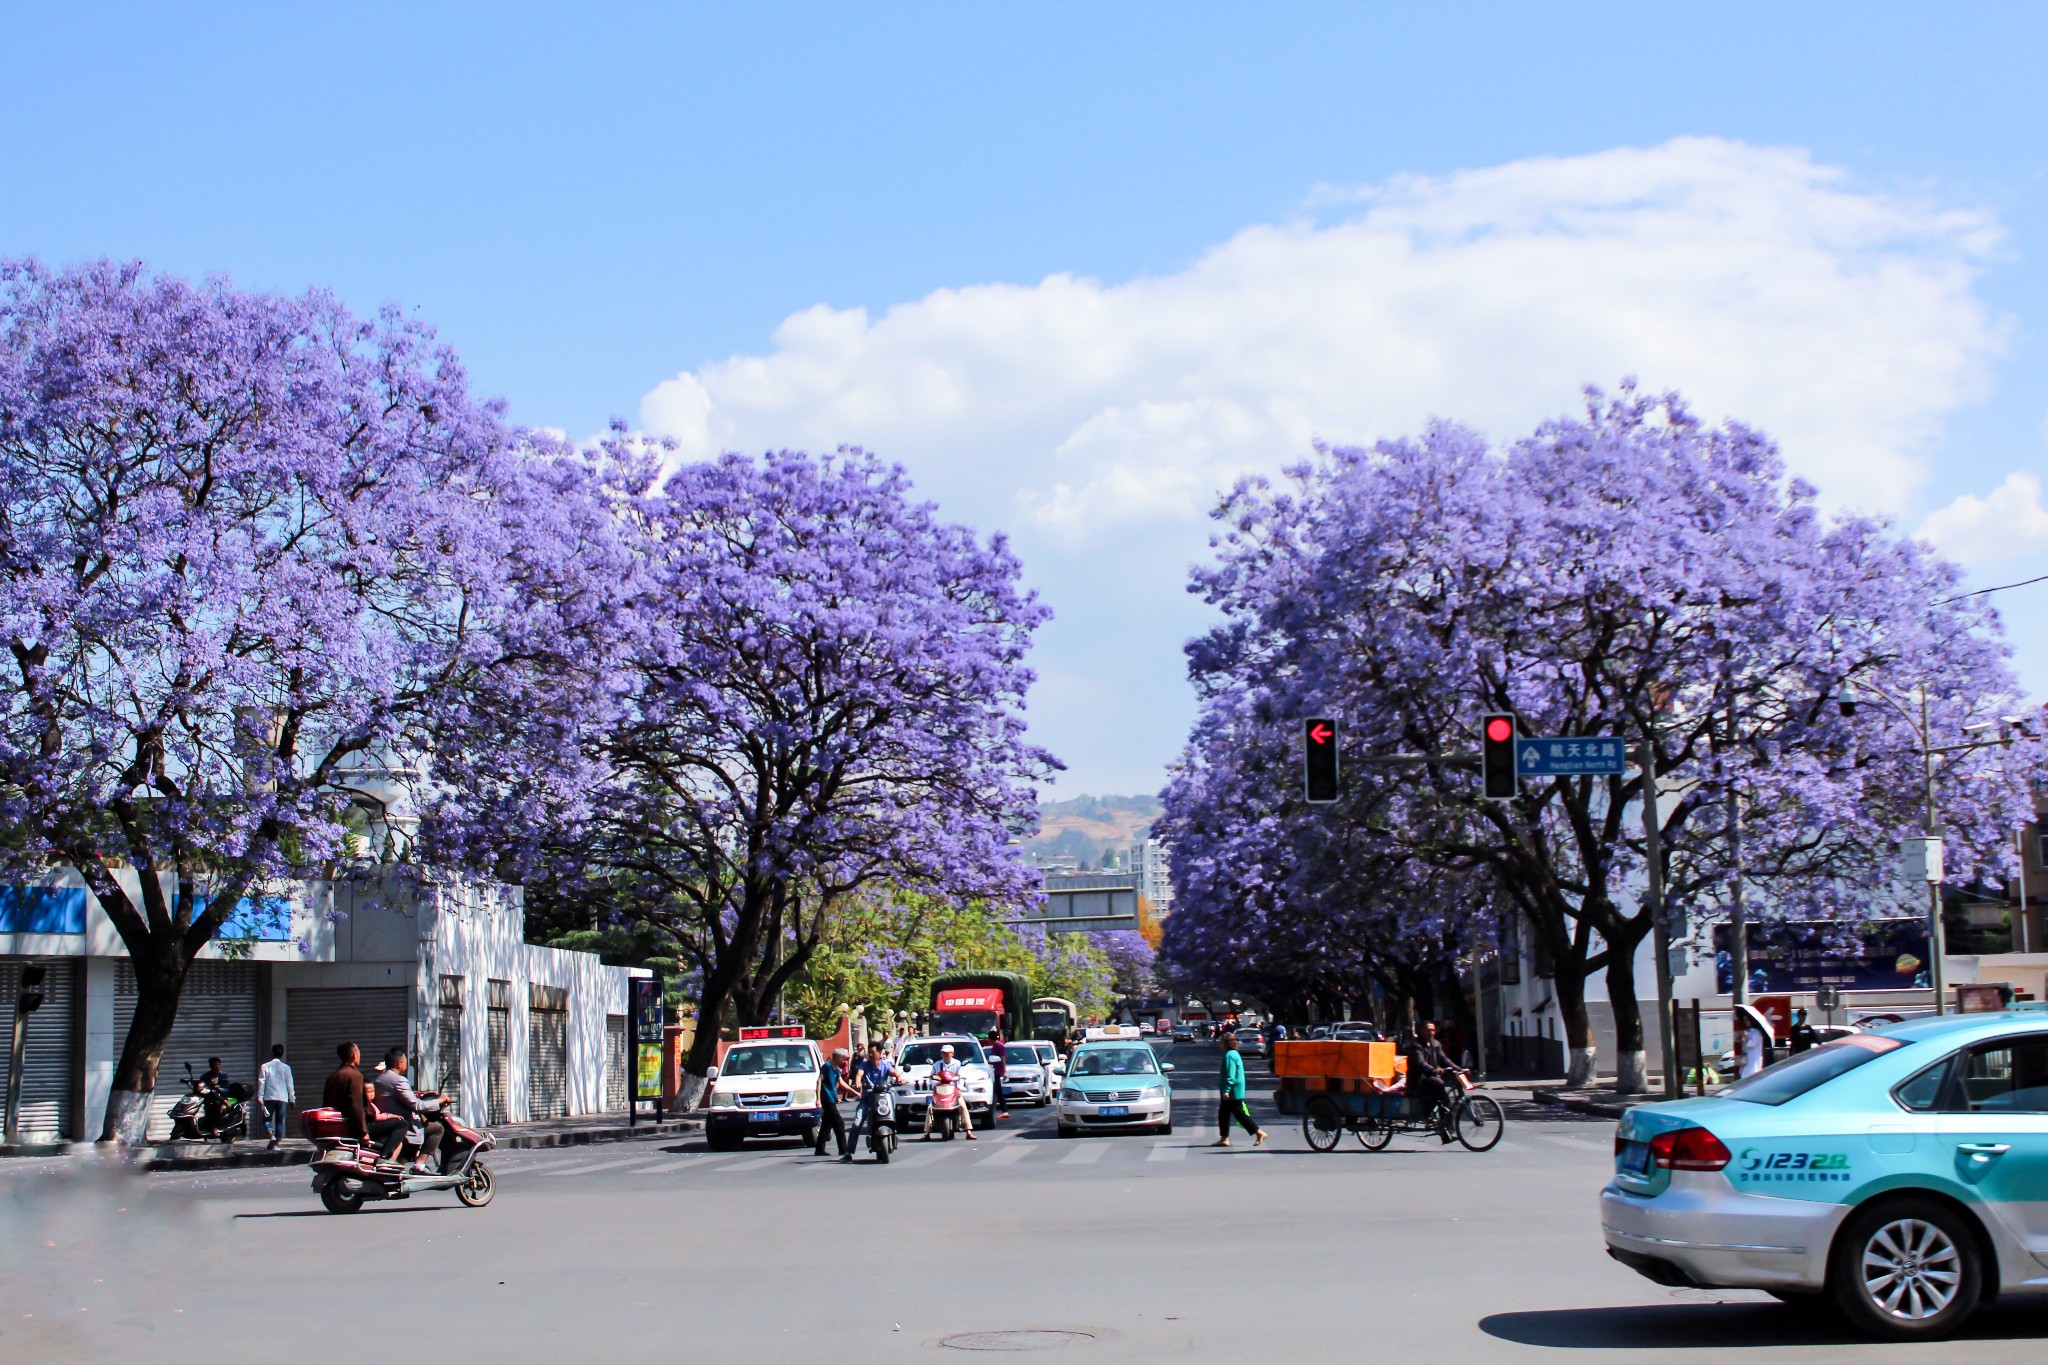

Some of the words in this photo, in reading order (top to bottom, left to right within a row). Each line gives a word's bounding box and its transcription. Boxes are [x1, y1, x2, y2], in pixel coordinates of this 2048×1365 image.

[1550, 743, 1616, 757] 航天北路
[1585, 760, 1605, 769] North
[1764, 1152, 1850, 1169] 12328
